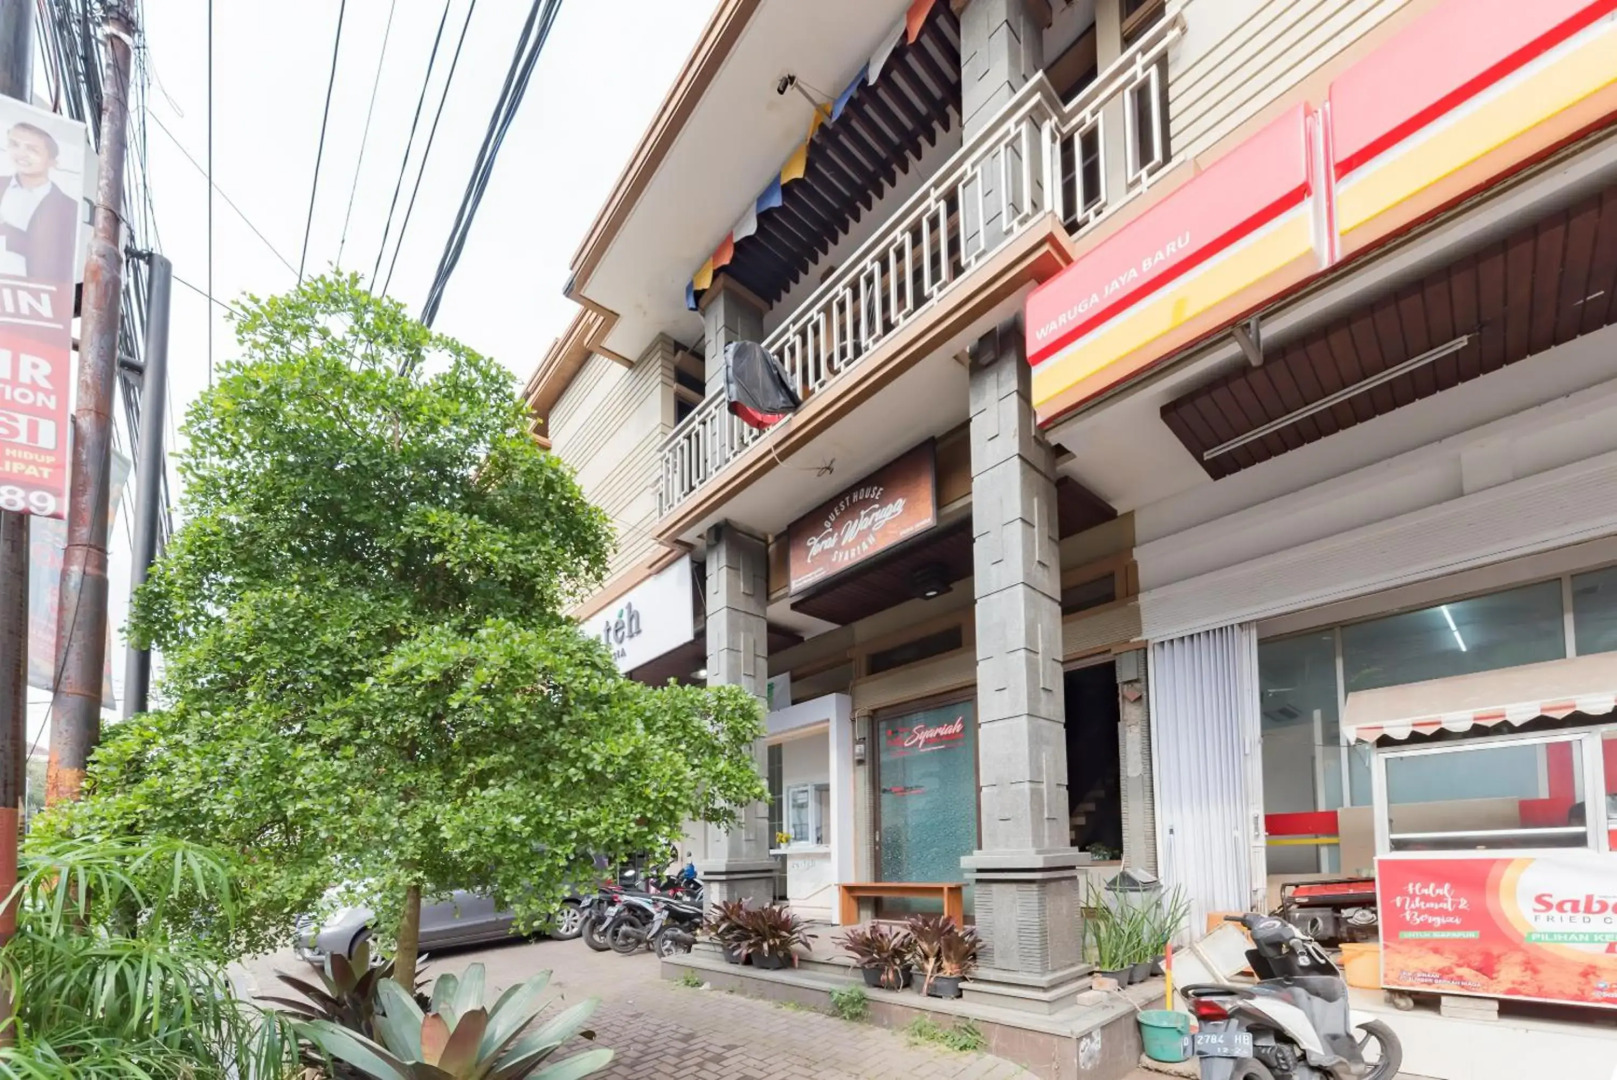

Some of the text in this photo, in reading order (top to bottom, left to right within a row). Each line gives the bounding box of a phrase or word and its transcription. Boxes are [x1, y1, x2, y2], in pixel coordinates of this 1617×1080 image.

[1035, 231, 1190, 341] WARUGA JAYA BARU
[0, 383, 56, 410] ION
[5, 448, 56, 464] HIDUP
[0, 485, 56, 516] 89
[852, 486, 884, 503] HOUSE
[832, 533, 876, 562] SYARIAH
[904, 716, 965, 749] Syariah
[1534, 915, 1592, 923] FRIED
[1531, 932, 1593, 941] PILIHAN
